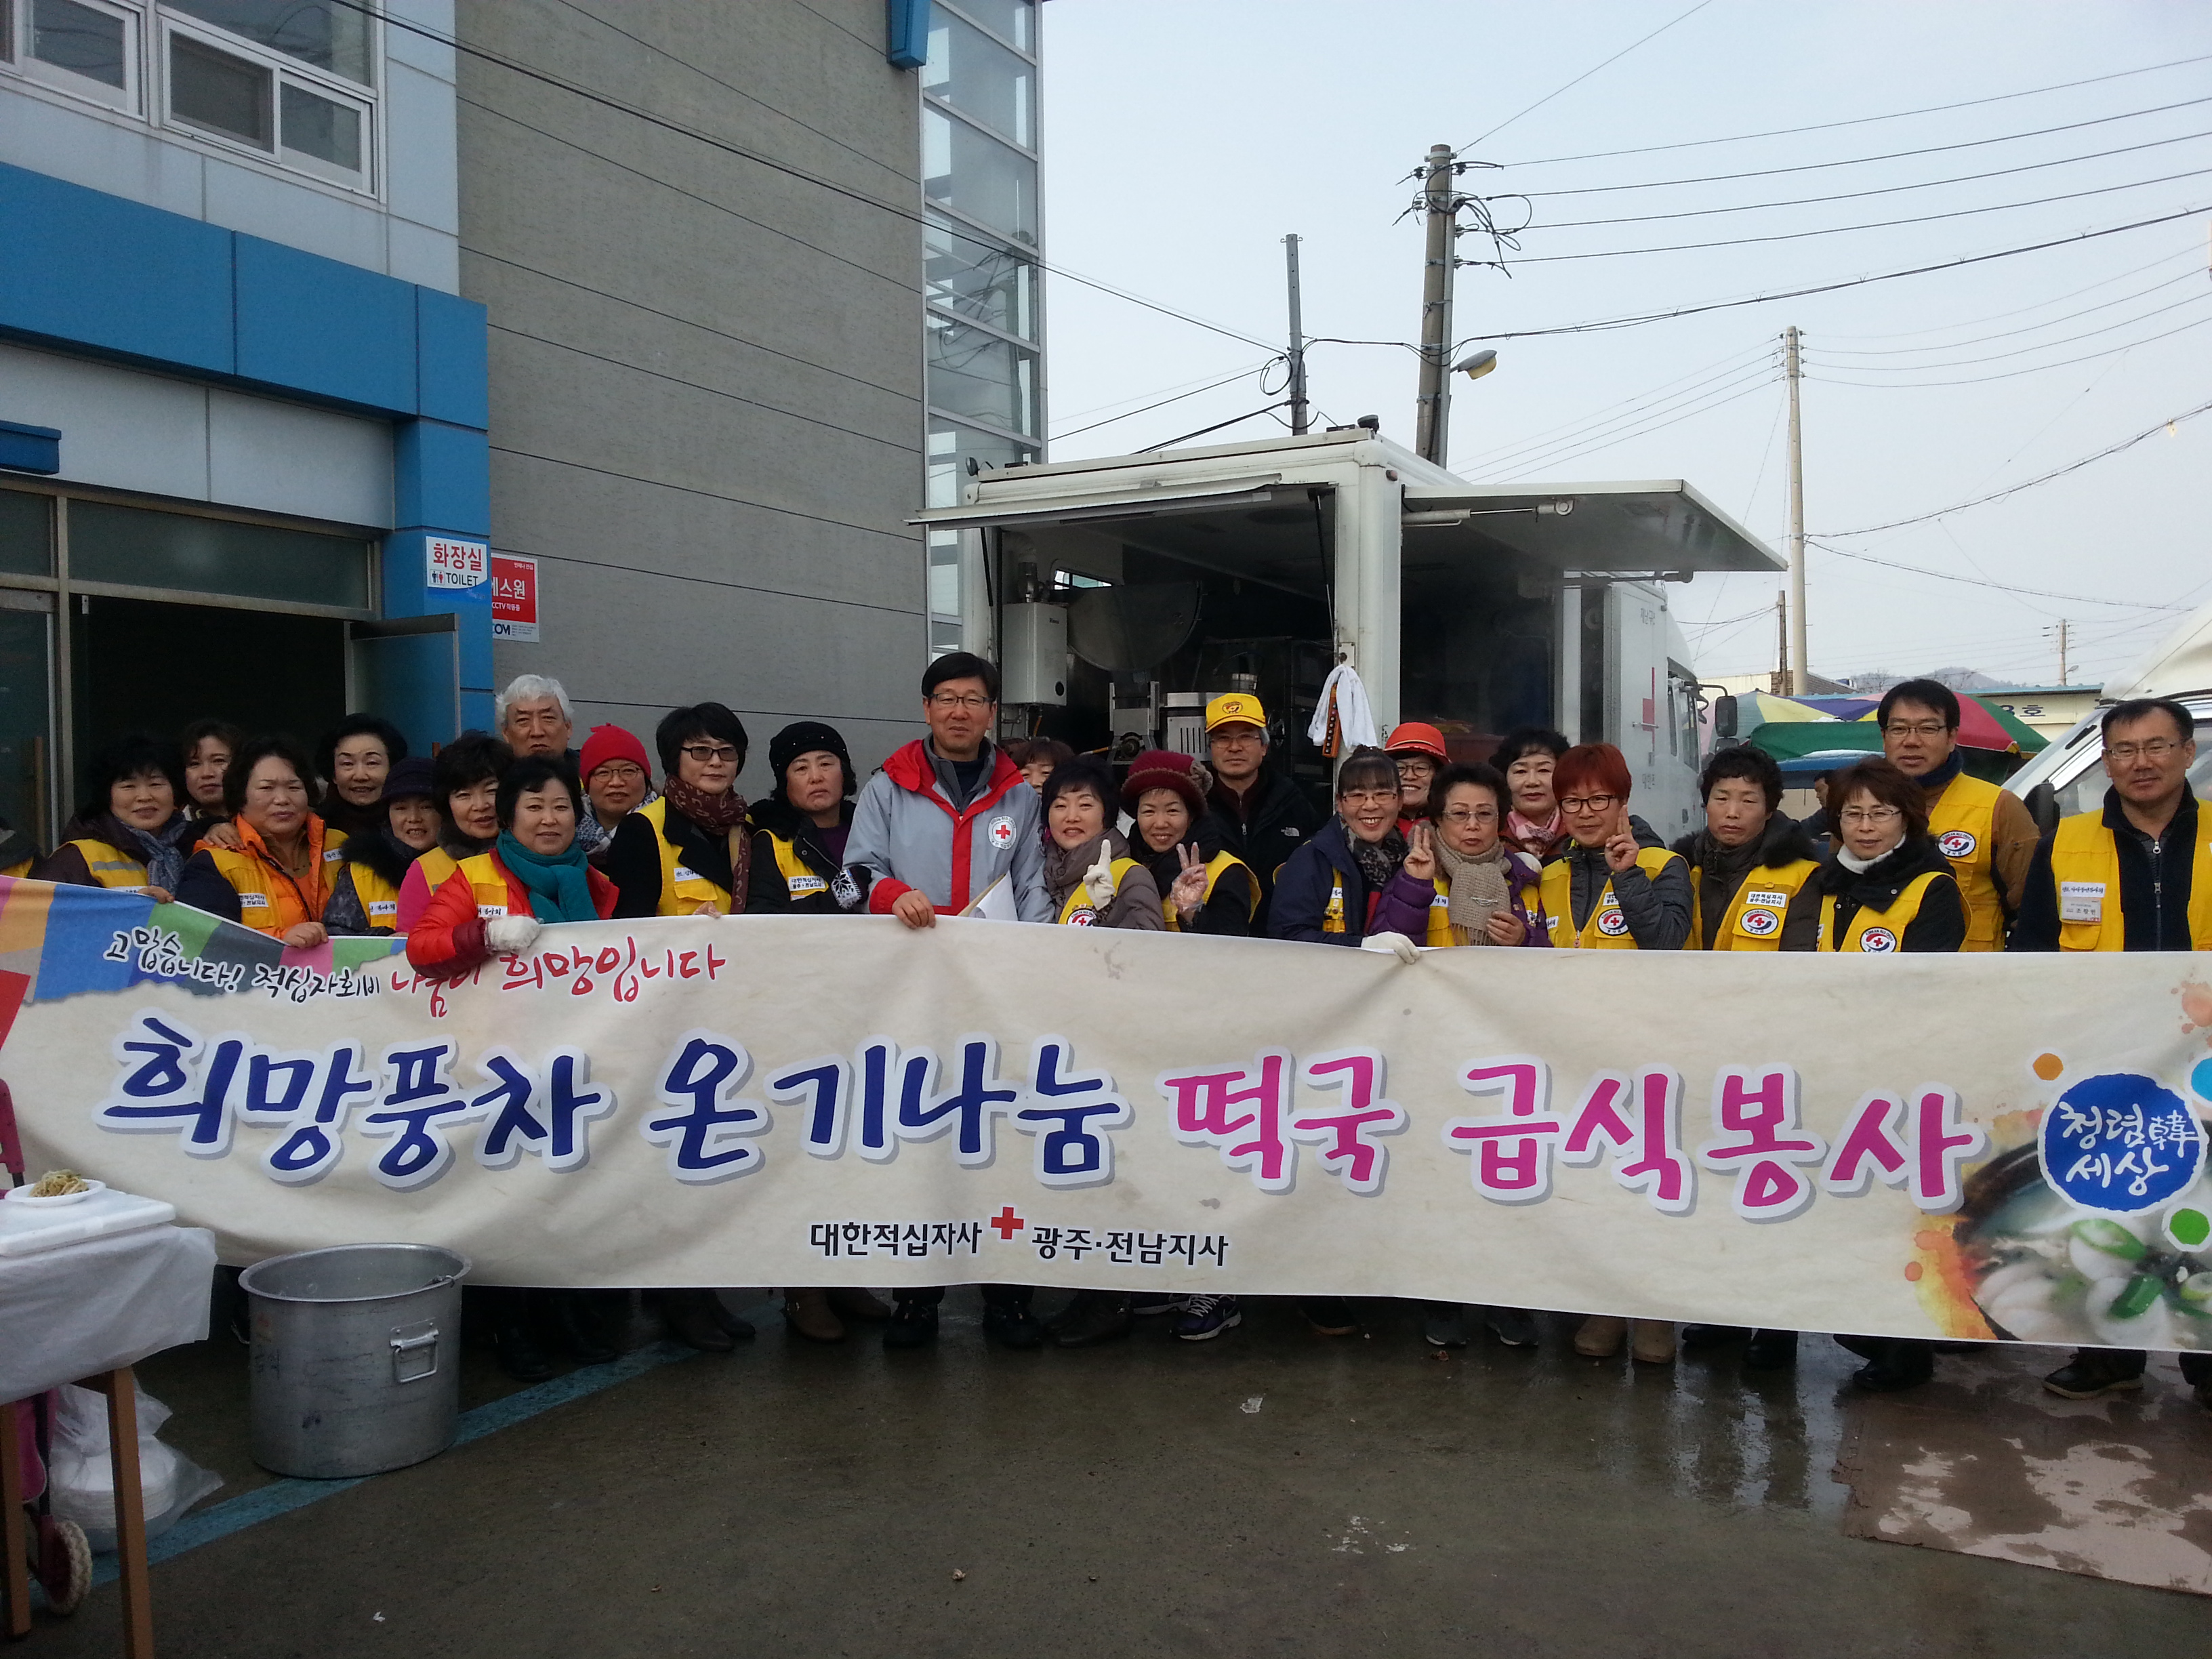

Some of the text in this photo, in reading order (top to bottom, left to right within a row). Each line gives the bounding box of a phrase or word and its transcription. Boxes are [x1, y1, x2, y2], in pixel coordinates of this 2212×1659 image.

[433, 543, 483, 572] 화장실
[445, 572, 478, 586] TOILET
[106, 926, 243, 990] 고맙습니다!
[255, 963, 381, 1002] 적십자회비
[499, 935, 726, 1002] 희망입니다
[104, 1017, 1973, 1208] 희망풍차 온기나눔 떡국 급식봉사
[2065, 1146, 2169, 1196] 세상
[811, 1221, 1229, 1266] 대한적십자사 광주·전남지사
